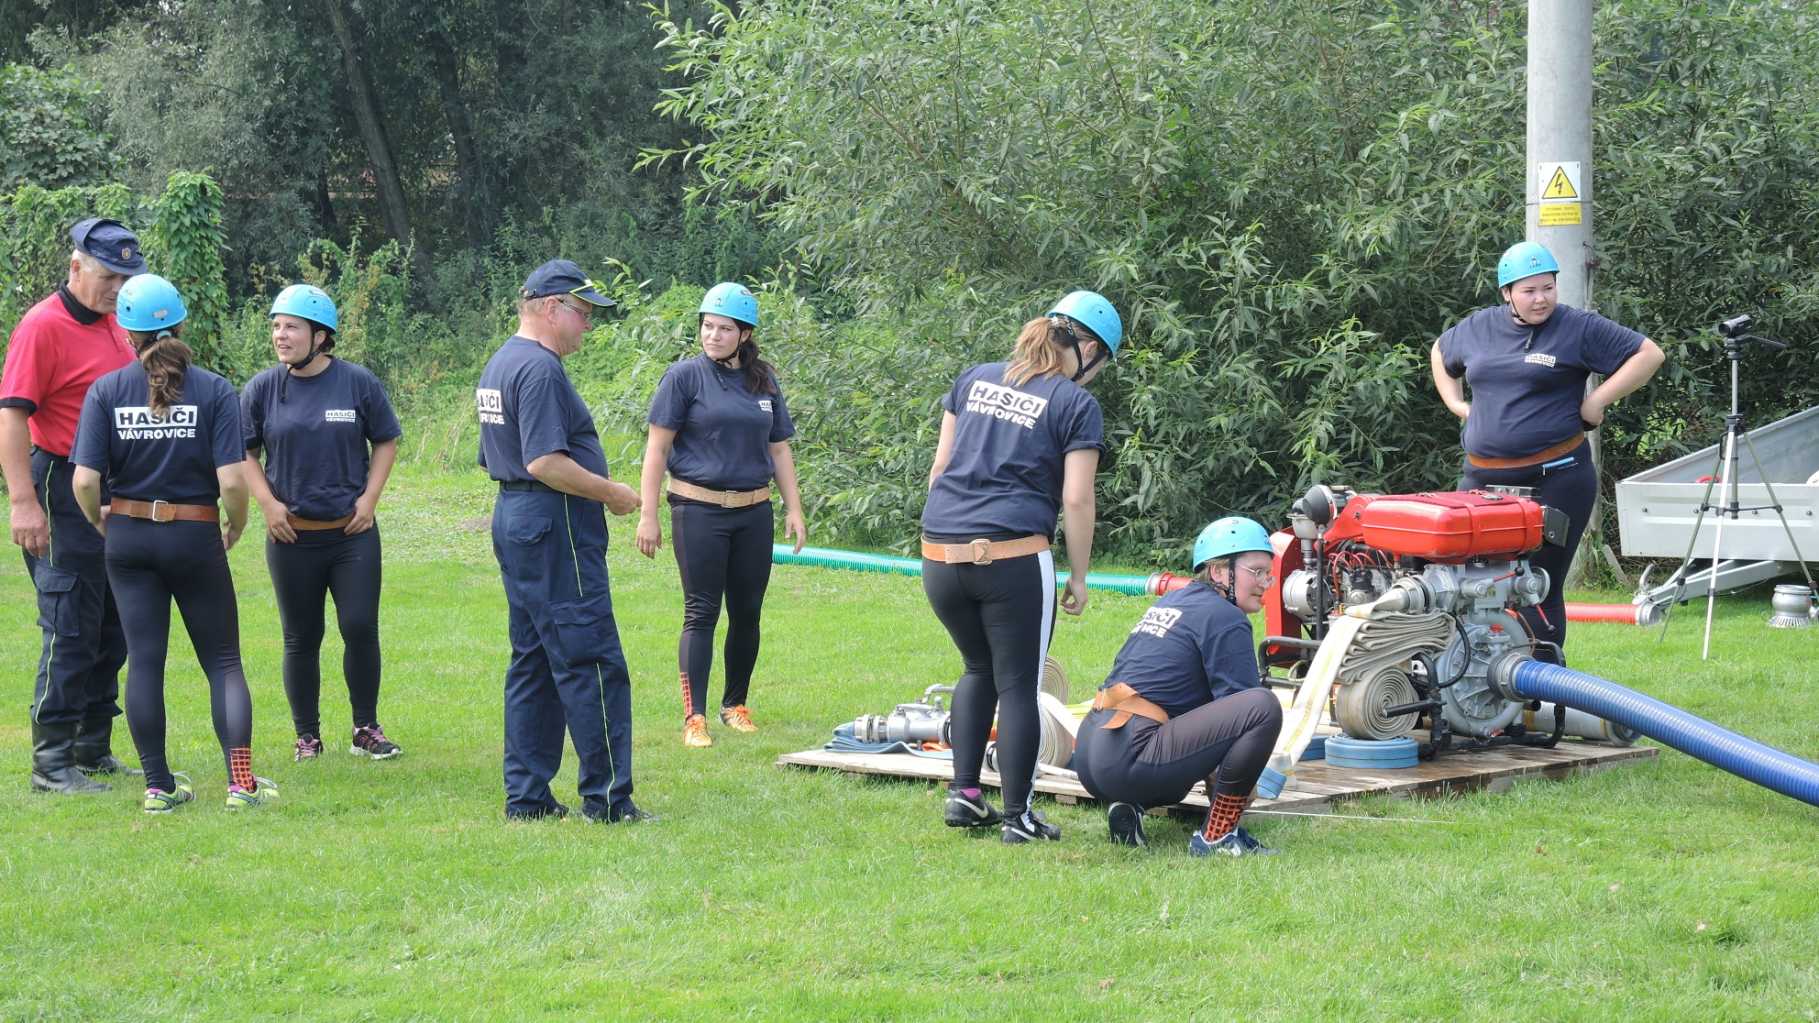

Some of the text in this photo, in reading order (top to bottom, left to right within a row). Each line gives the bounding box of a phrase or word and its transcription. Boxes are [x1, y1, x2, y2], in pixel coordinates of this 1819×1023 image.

[973, 385, 1042, 415] HASIČI
[119, 406, 195, 426] HASIČI
[117, 427, 197, 440] VÁVROVICE
